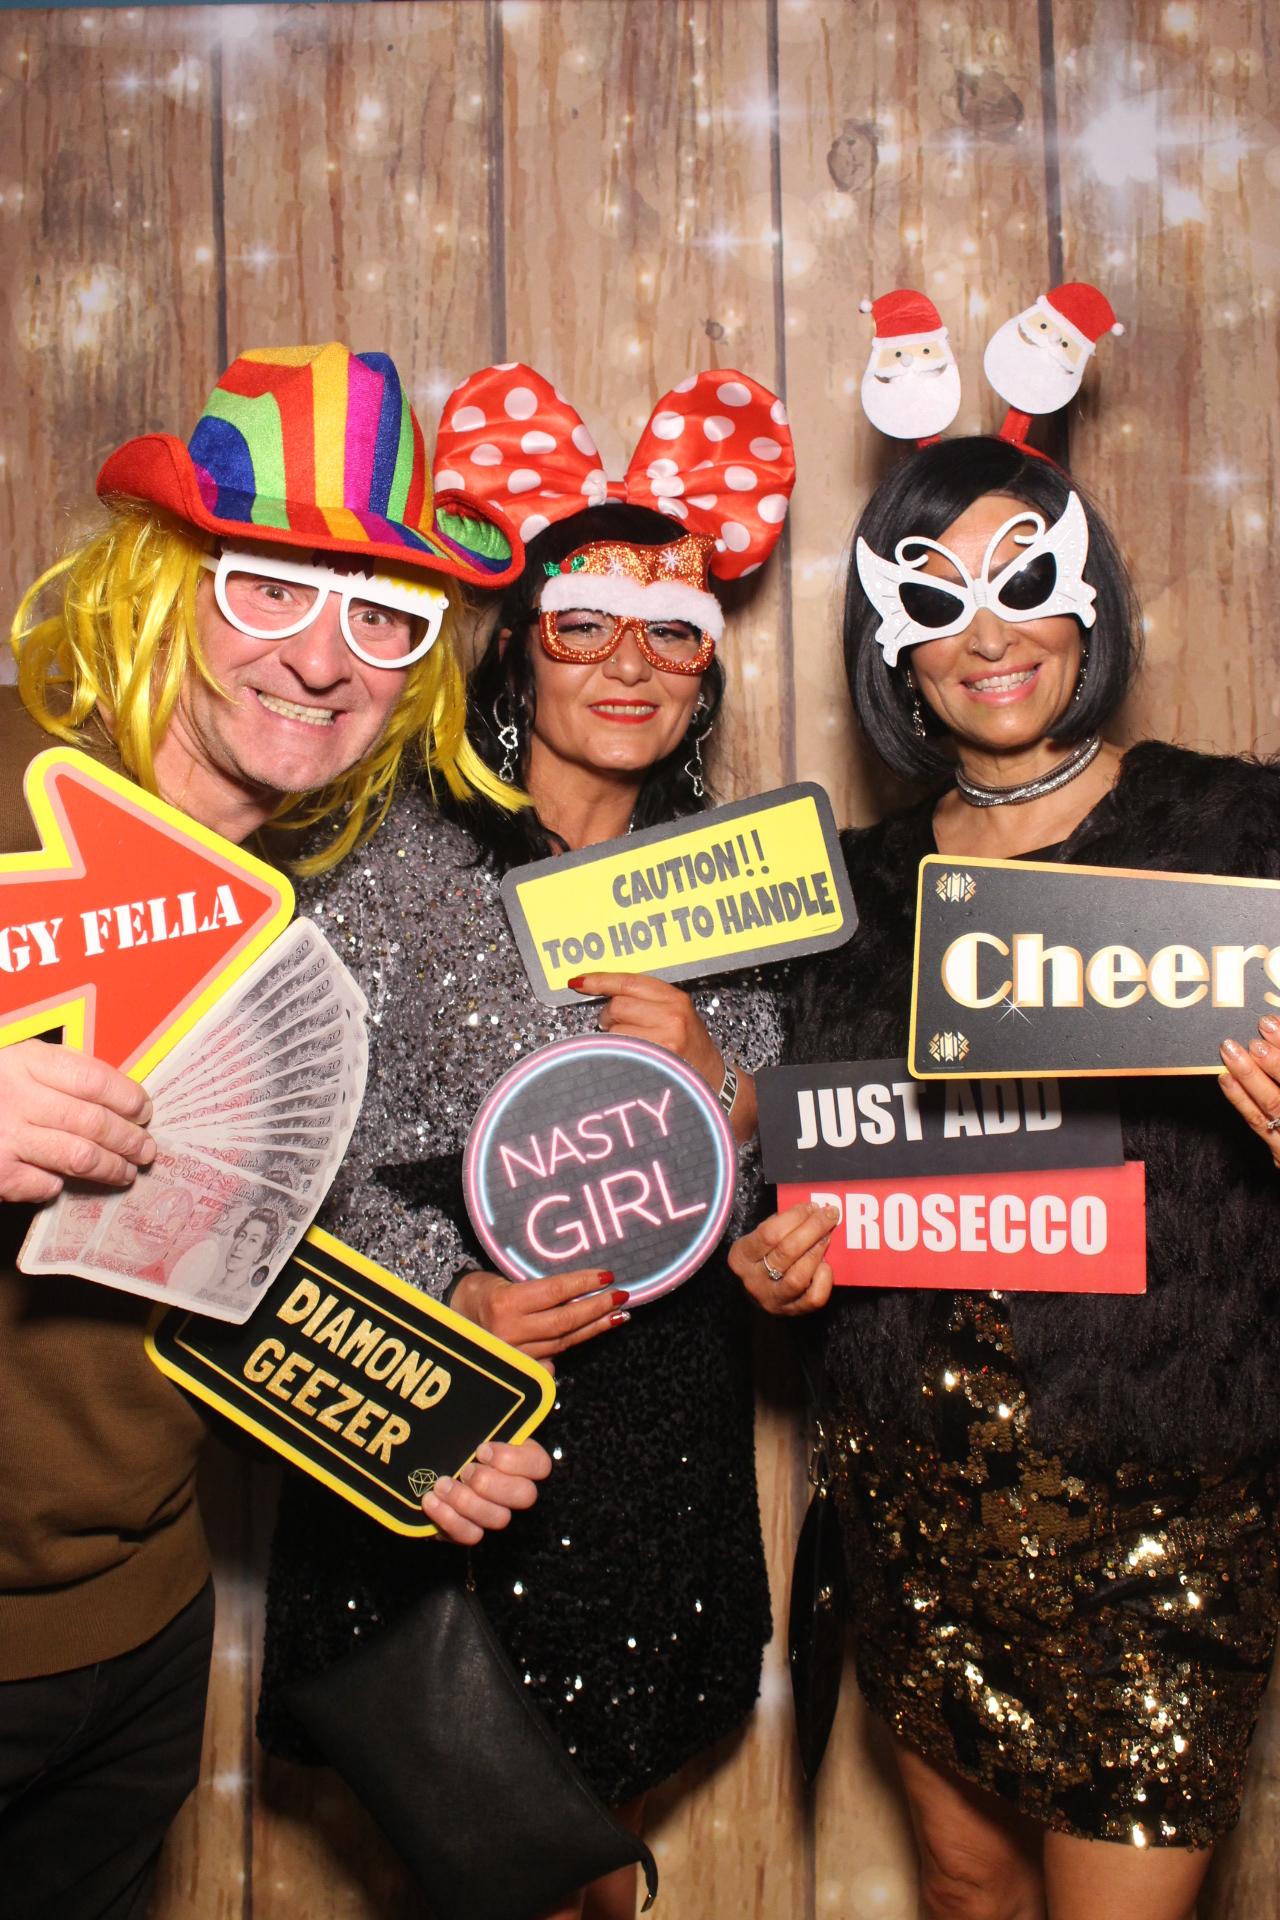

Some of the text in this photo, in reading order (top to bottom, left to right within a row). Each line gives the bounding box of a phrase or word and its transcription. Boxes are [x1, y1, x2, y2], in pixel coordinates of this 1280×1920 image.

[612, 829, 770, 908] CAUTION!!
[0, 885, 243, 973] GY FELLA
[542, 871, 836, 969] TOO HOT TO HANDLE
[499, 1088, 672, 1189] NASTY
[797, 1080, 927, 1149] JUST
[943, 1078, 1063, 1138] ADD
[526, 1160, 707, 1260] GIRL
[276, 1277, 452, 1410] DIAMOND
[243, 1338, 412, 1465] GEEZER
